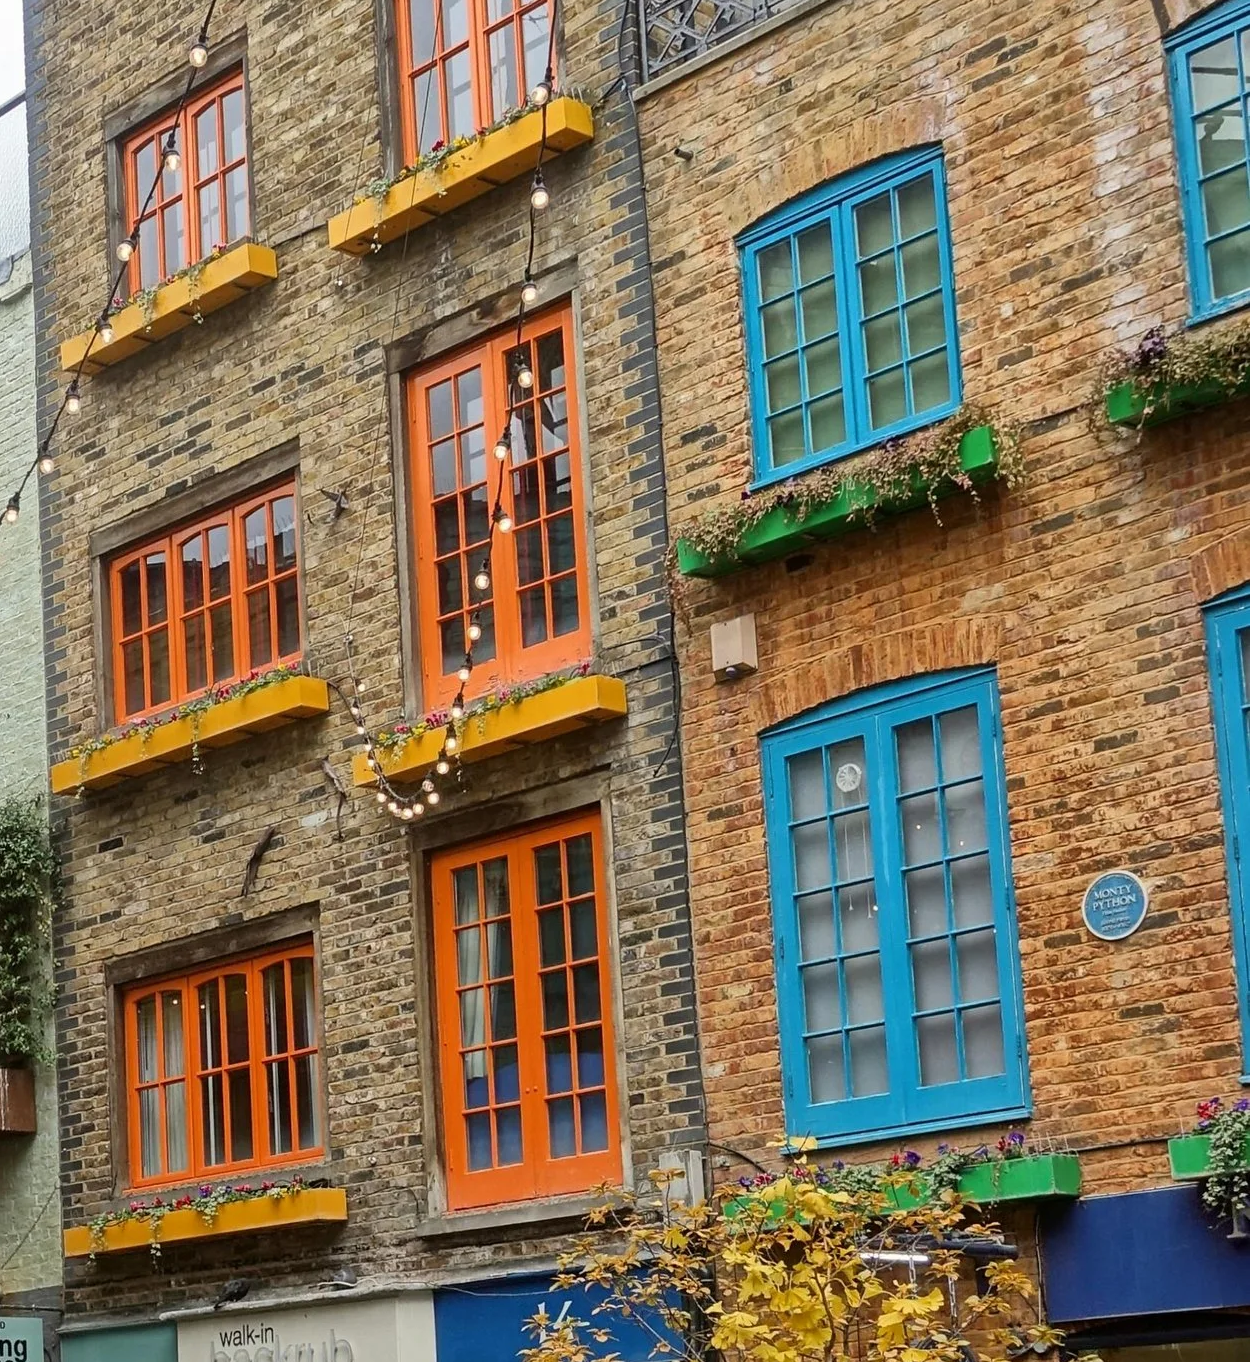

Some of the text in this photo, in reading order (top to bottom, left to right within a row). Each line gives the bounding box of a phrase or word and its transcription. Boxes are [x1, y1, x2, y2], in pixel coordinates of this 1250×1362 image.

[1094, 884, 1132, 900] MONTY
[1093, 893, 1137, 911] PYTHON
[219, 1322, 275, 1348] walk-in
